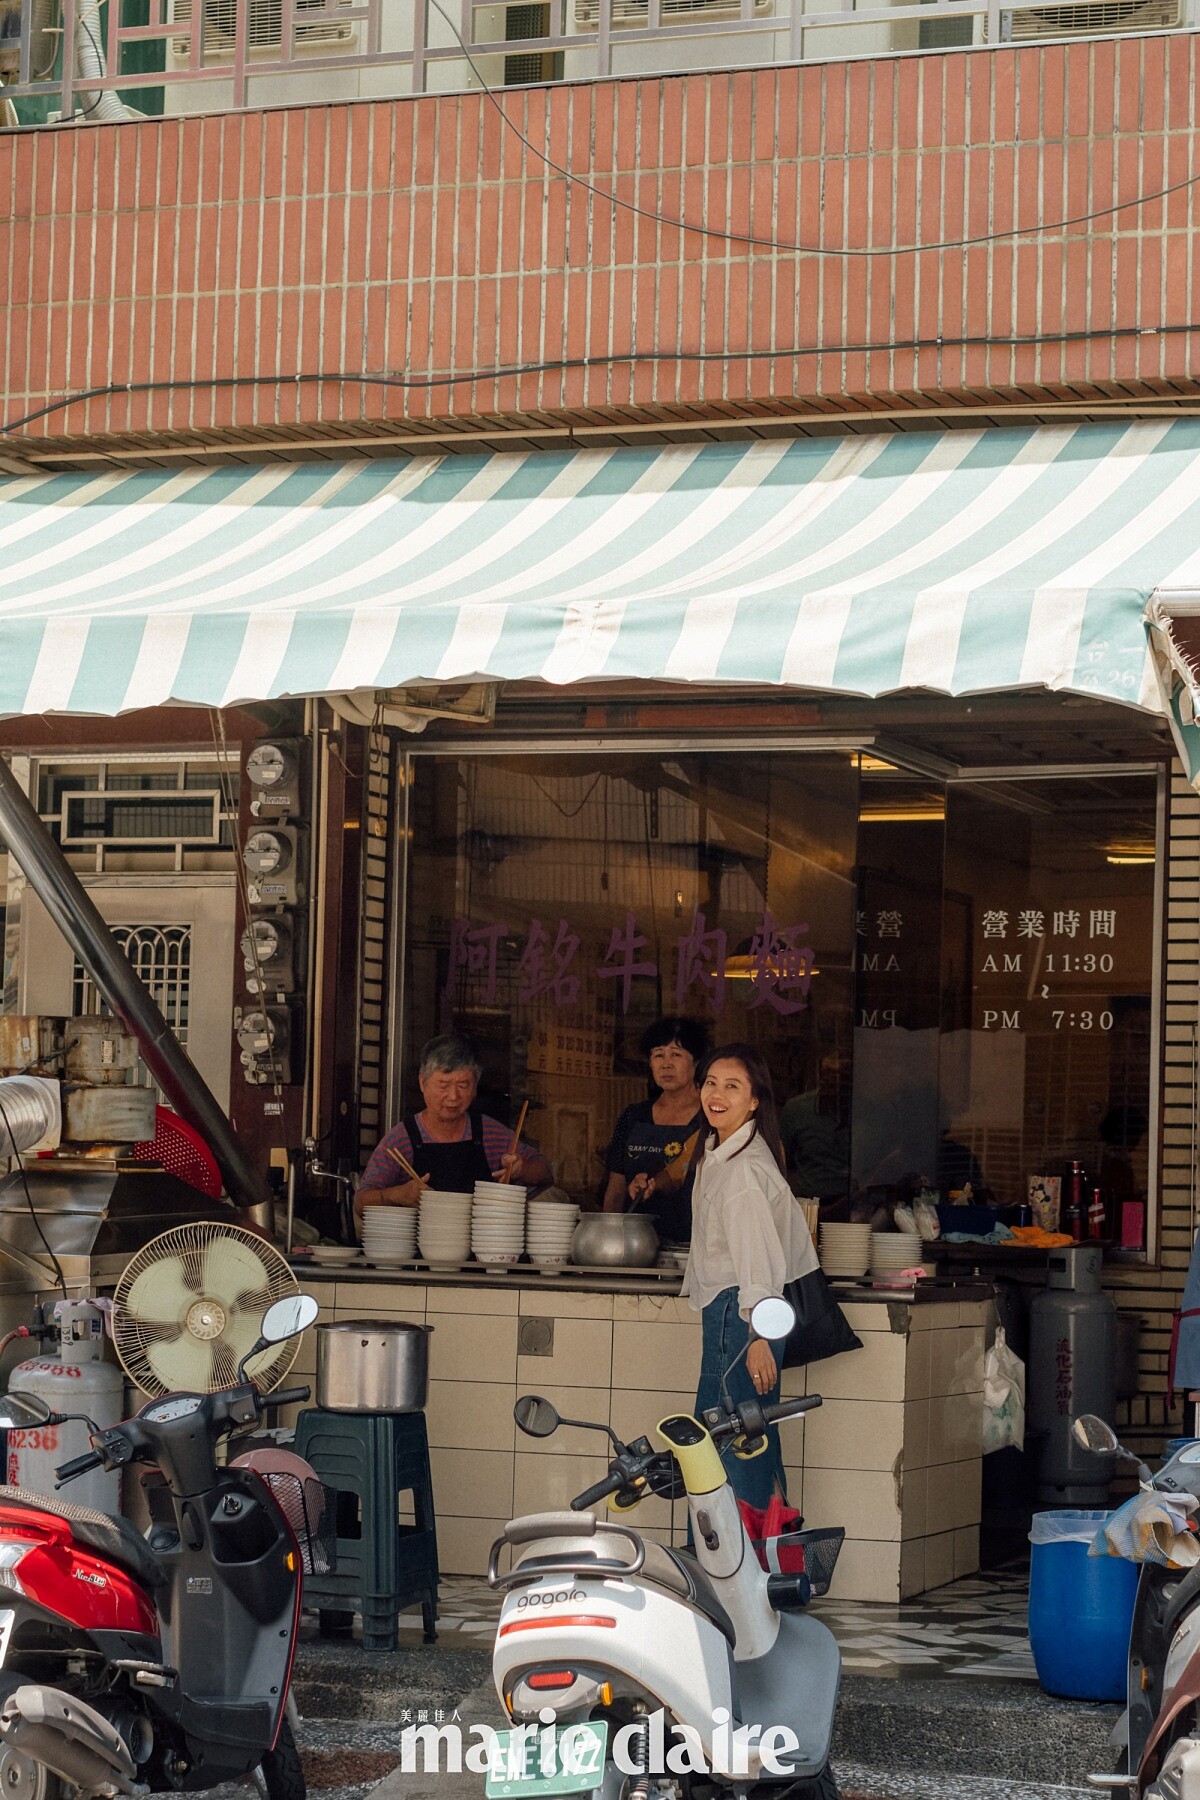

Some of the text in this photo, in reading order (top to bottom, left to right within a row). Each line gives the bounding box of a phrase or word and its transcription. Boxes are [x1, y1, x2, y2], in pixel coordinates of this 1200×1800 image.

[981, 909, 1117, 939] 營業時間
[446, 912, 815, 1015] 阿銘牛肉麵
[981, 953, 1114, 973] AM 11:30
[982, 1010, 1114, 1030] PM 7:30
[517, 1588, 588, 1613] gogoro
